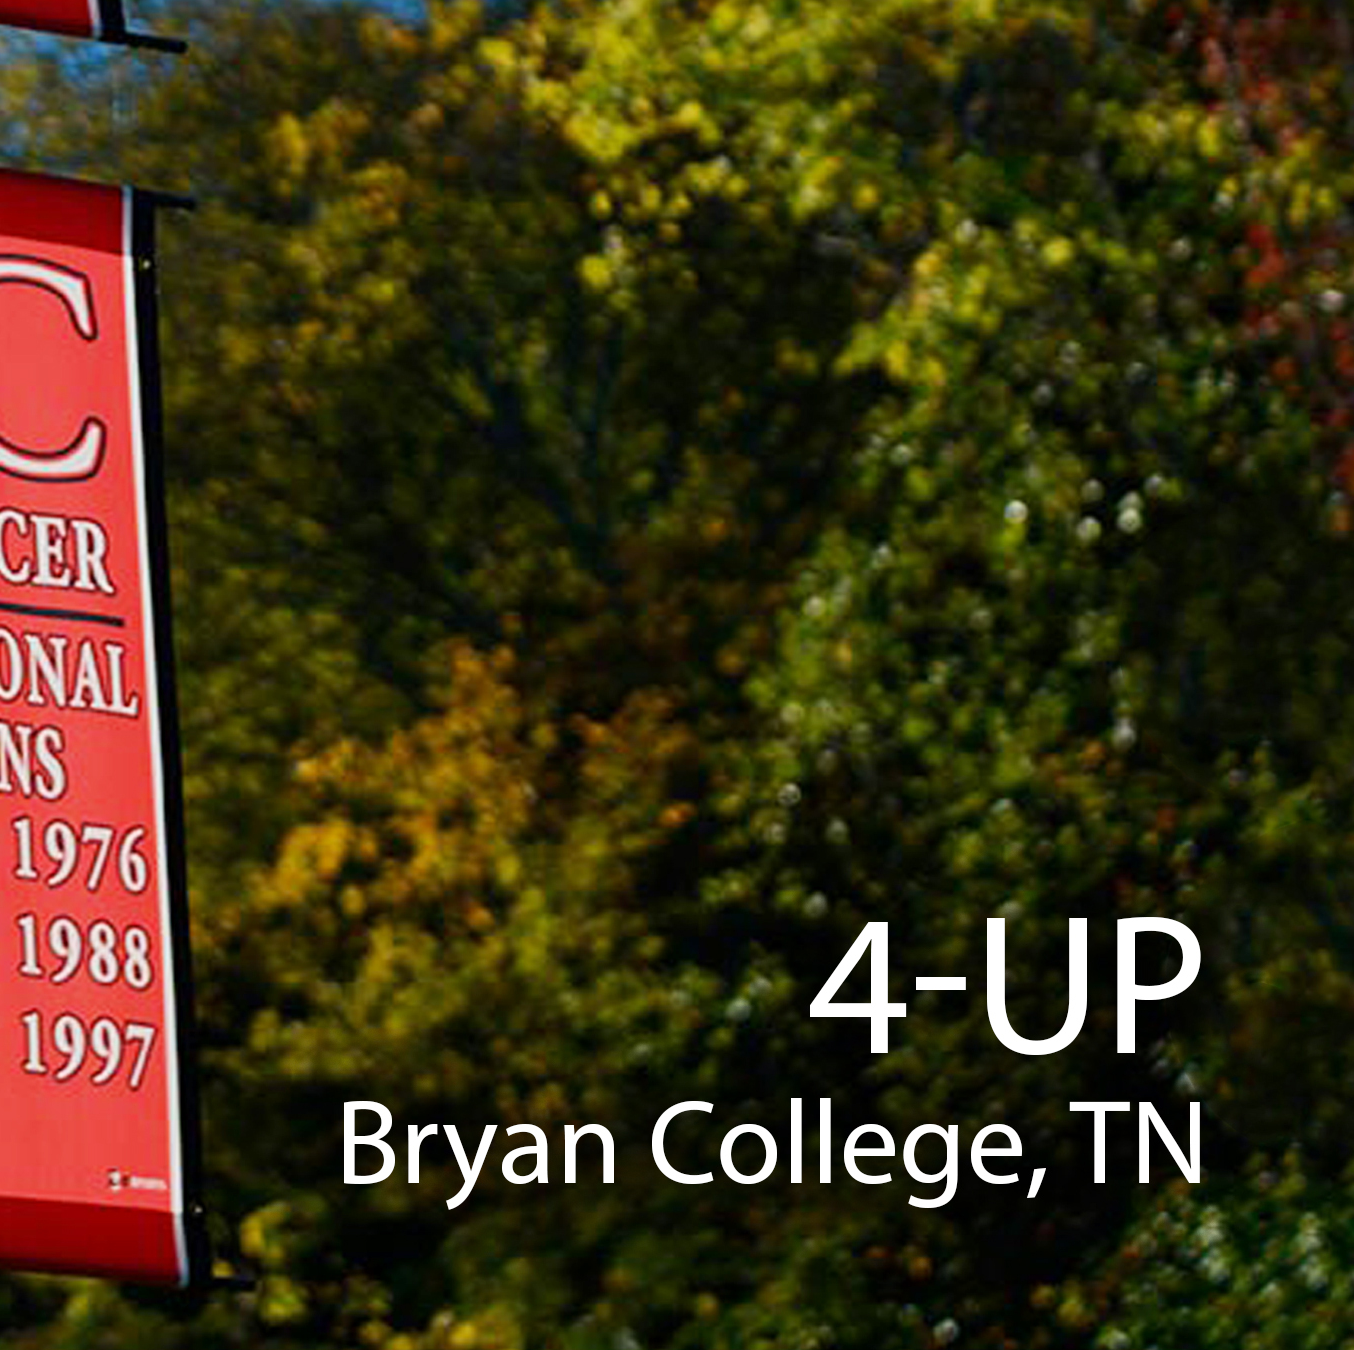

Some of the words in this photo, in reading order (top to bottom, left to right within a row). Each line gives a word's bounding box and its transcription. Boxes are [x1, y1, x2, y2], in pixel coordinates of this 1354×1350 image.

[12, 817, 148, 893] 1976
[17, 914, 152, 990] 1988
[22, 1011, 156, 1088] 1997
